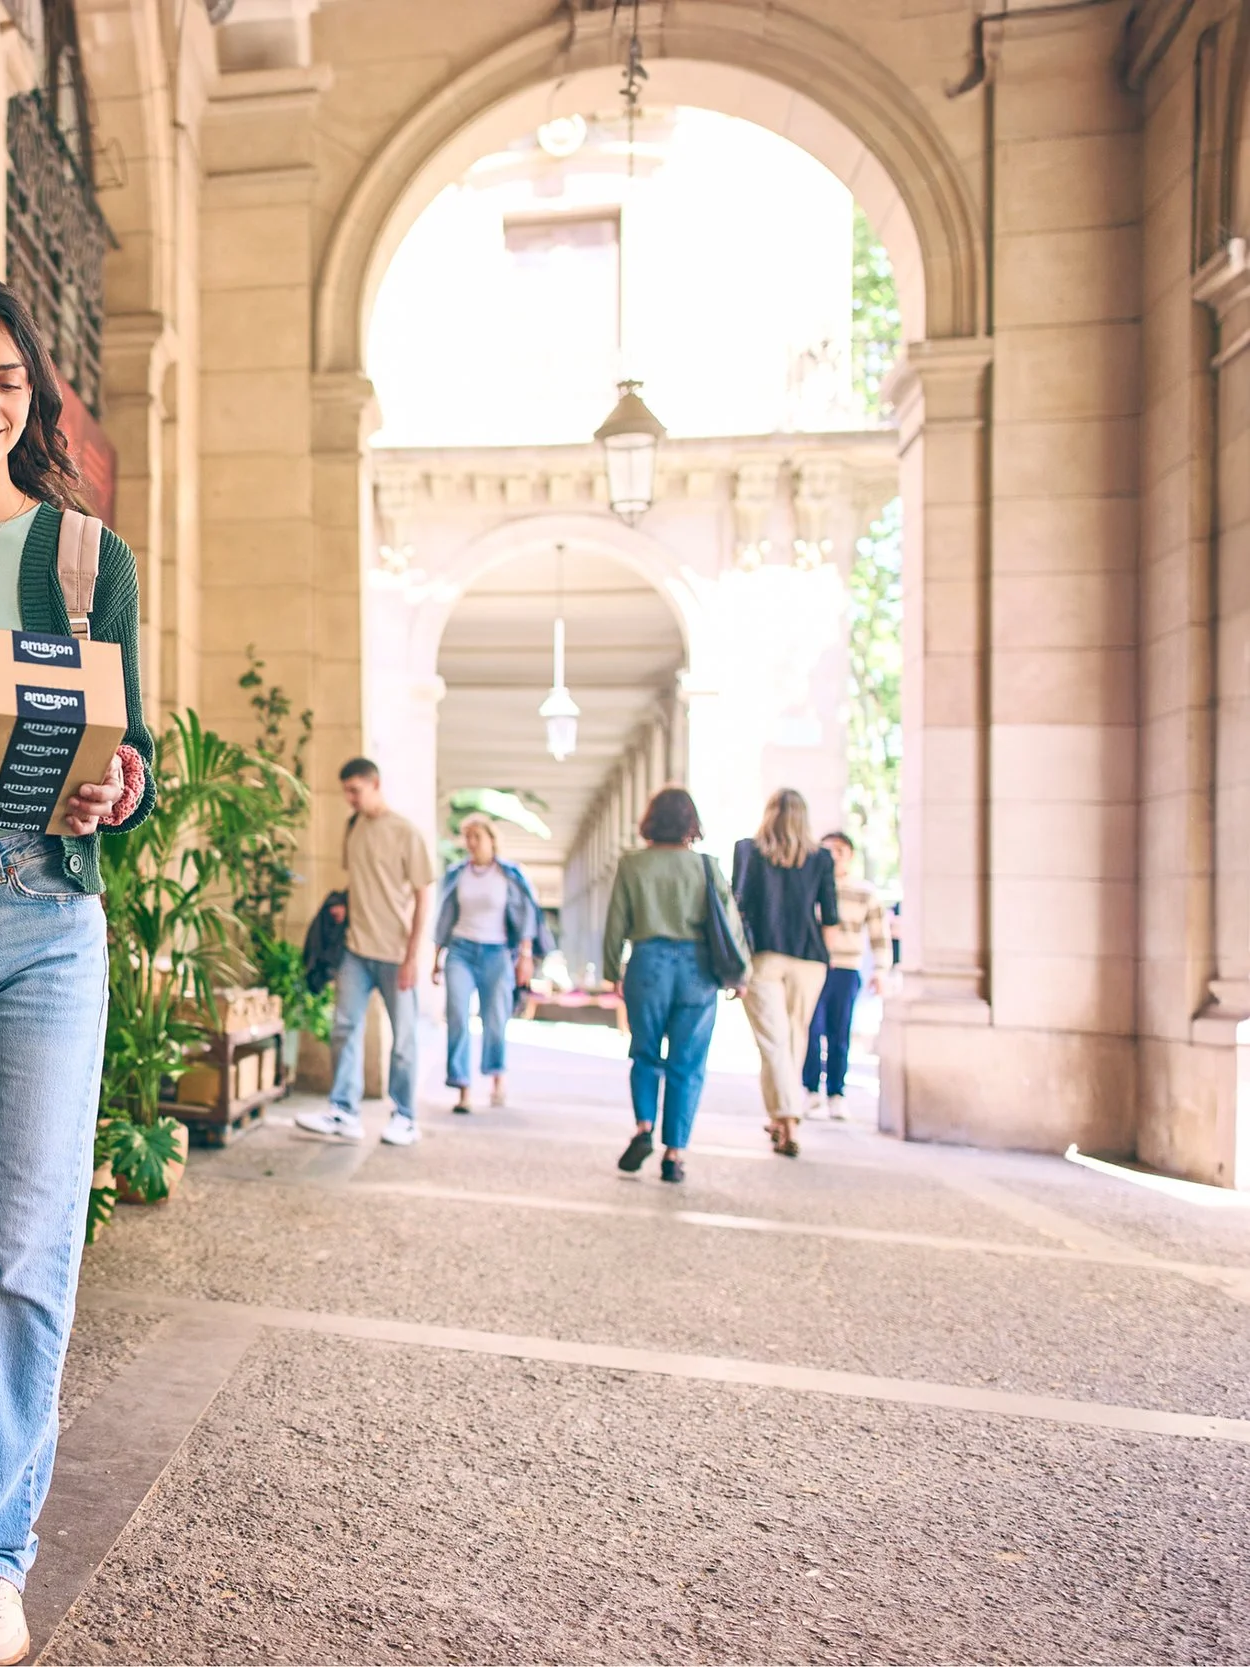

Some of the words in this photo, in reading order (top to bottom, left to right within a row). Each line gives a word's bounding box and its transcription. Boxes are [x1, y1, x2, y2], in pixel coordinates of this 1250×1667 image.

[20, 639, 74, 656] amazon
[24, 690, 79, 708] amazon
[22, 721, 77, 735] amazon
[16, 742, 69, 756] amazon
[9, 762, 62, 776] amazon
[2, 781, 54, 795] amazon
